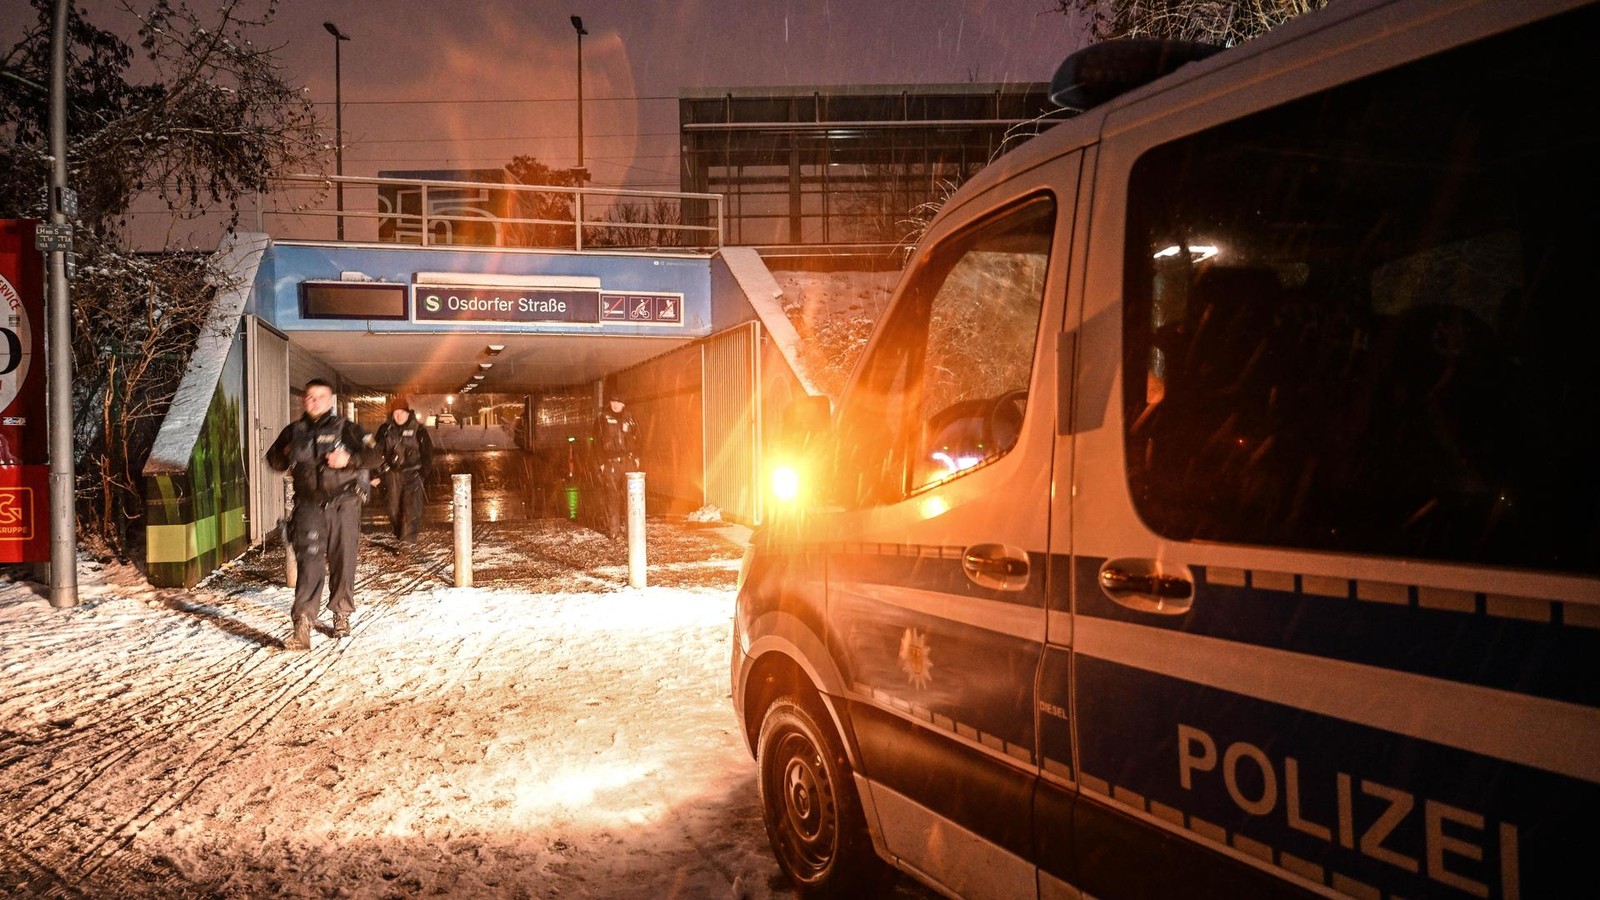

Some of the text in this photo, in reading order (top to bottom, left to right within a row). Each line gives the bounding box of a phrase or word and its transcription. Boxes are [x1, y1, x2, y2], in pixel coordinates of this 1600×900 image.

[447, 295, 514, 312] Osdorfer
[518, 297, 567, 313] Straße
[1039, 700, 1069, 720] DIESEL
[1177, 723, 1521, 900] POLIZEI
